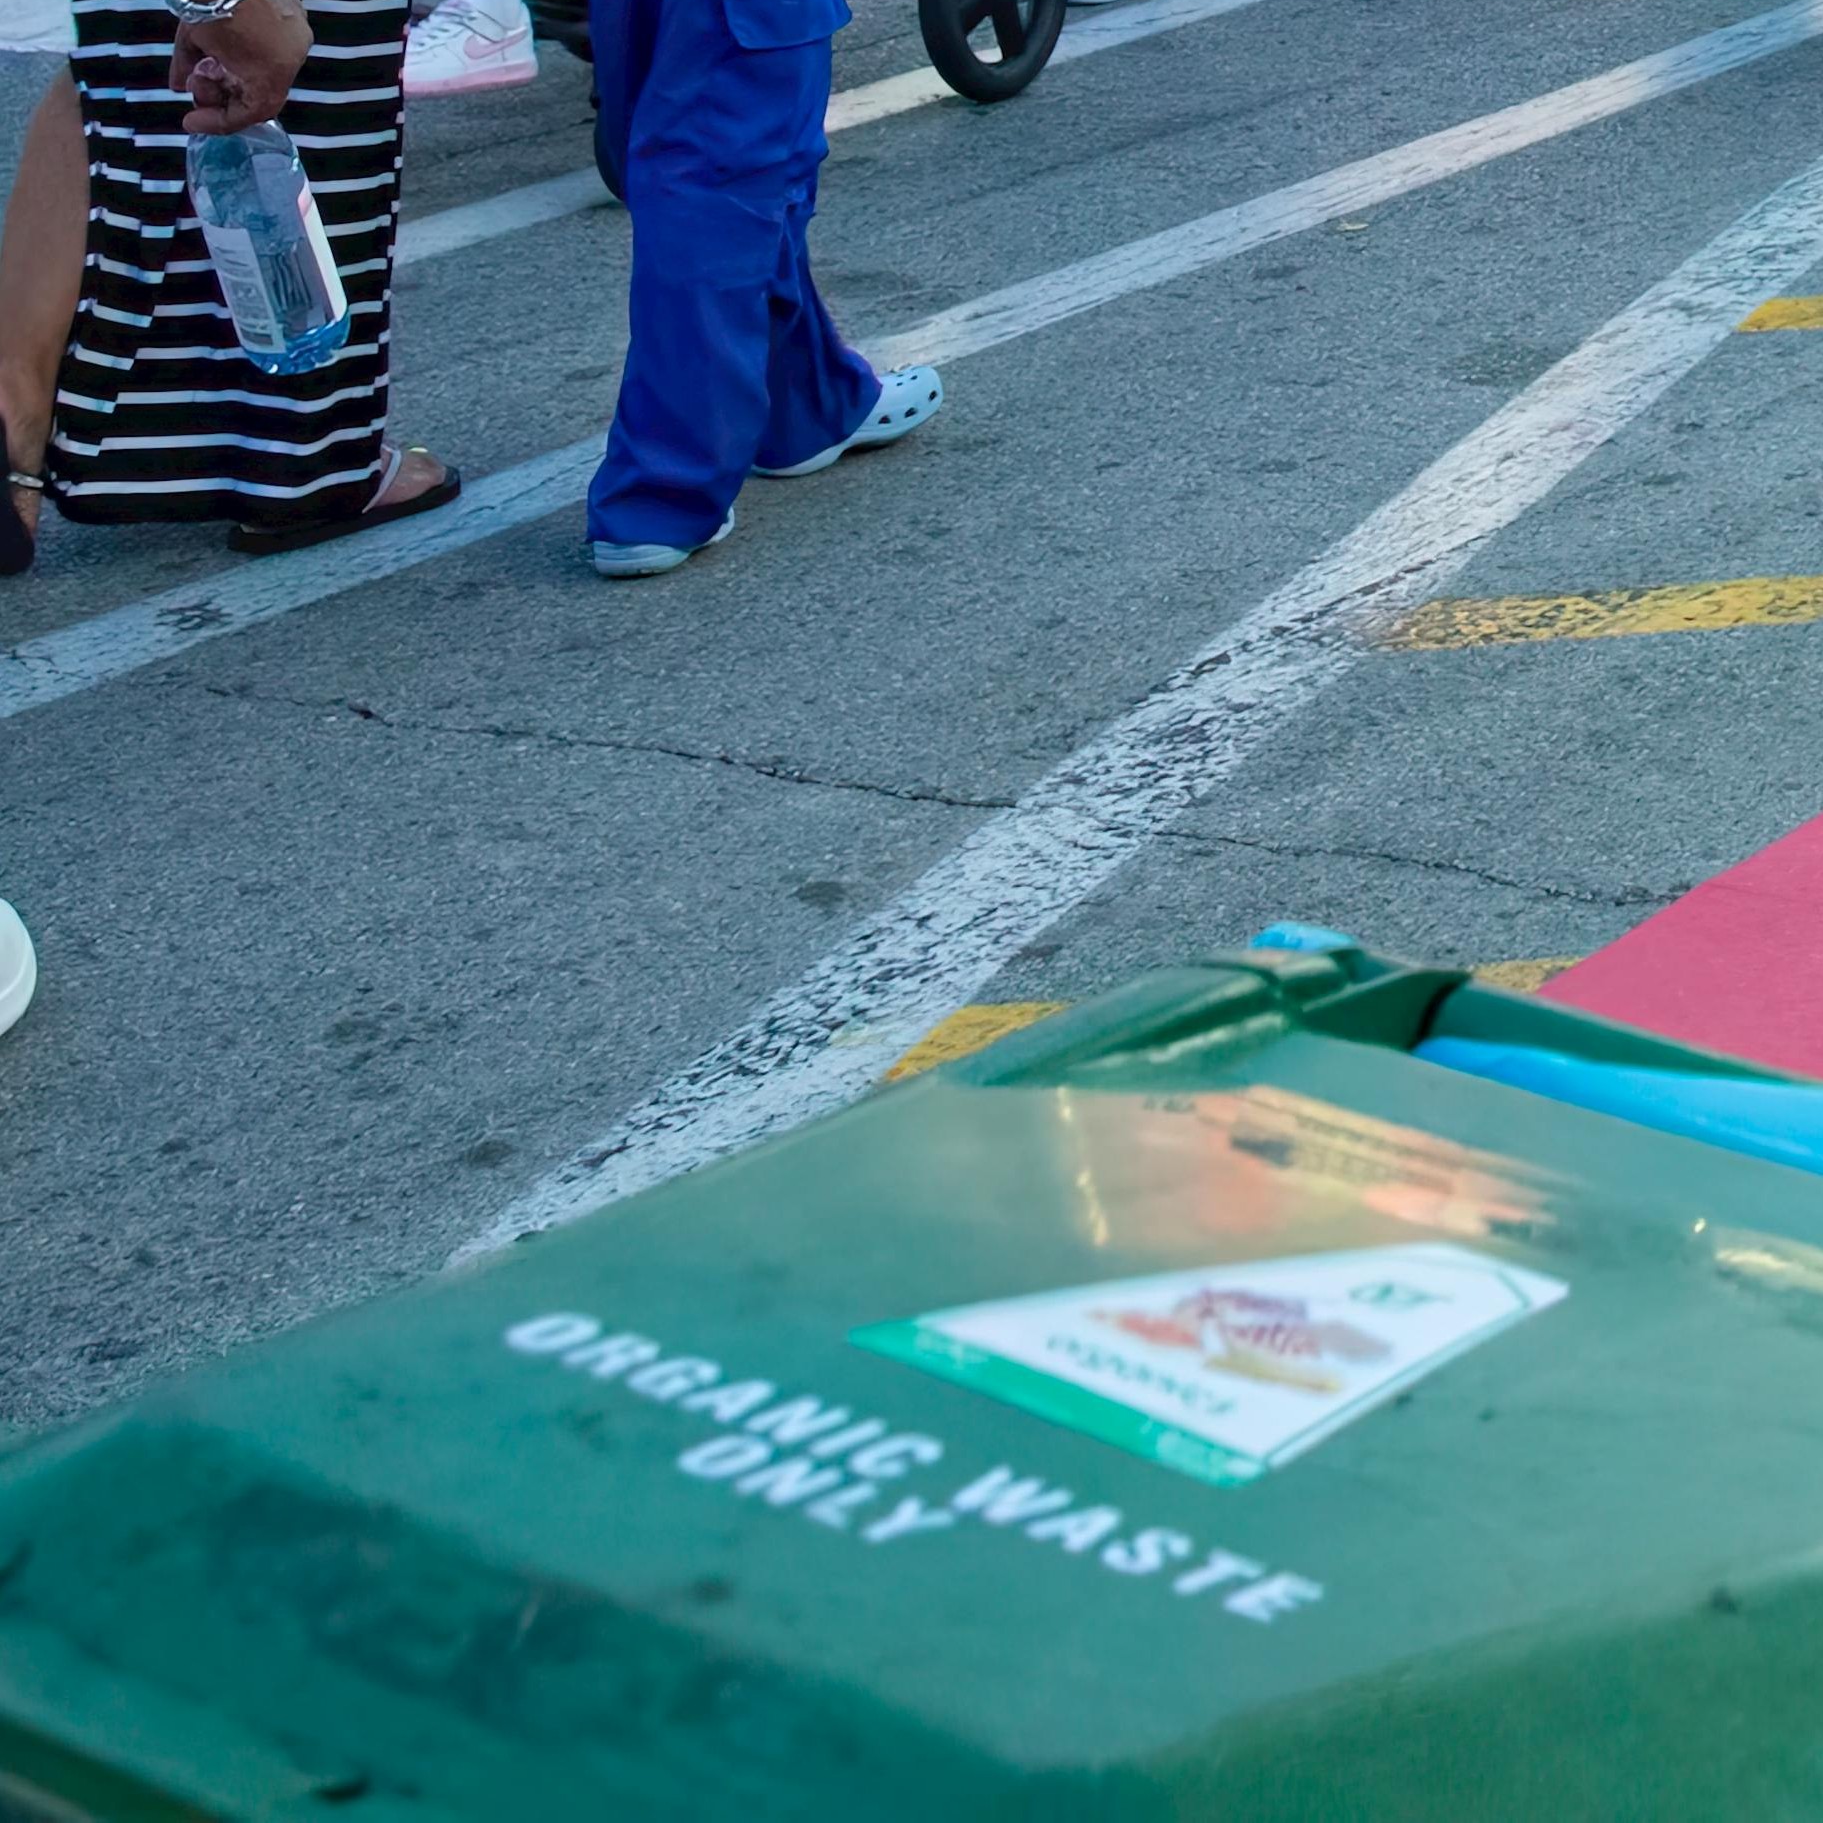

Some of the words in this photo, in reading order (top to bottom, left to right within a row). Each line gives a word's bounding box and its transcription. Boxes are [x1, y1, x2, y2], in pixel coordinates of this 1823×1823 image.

[503, 1310, 946, 1481] ORGANIC
[950, 1465, 1325, 1625] WASTE
[675, 1432, 956, 1544] ONLY
